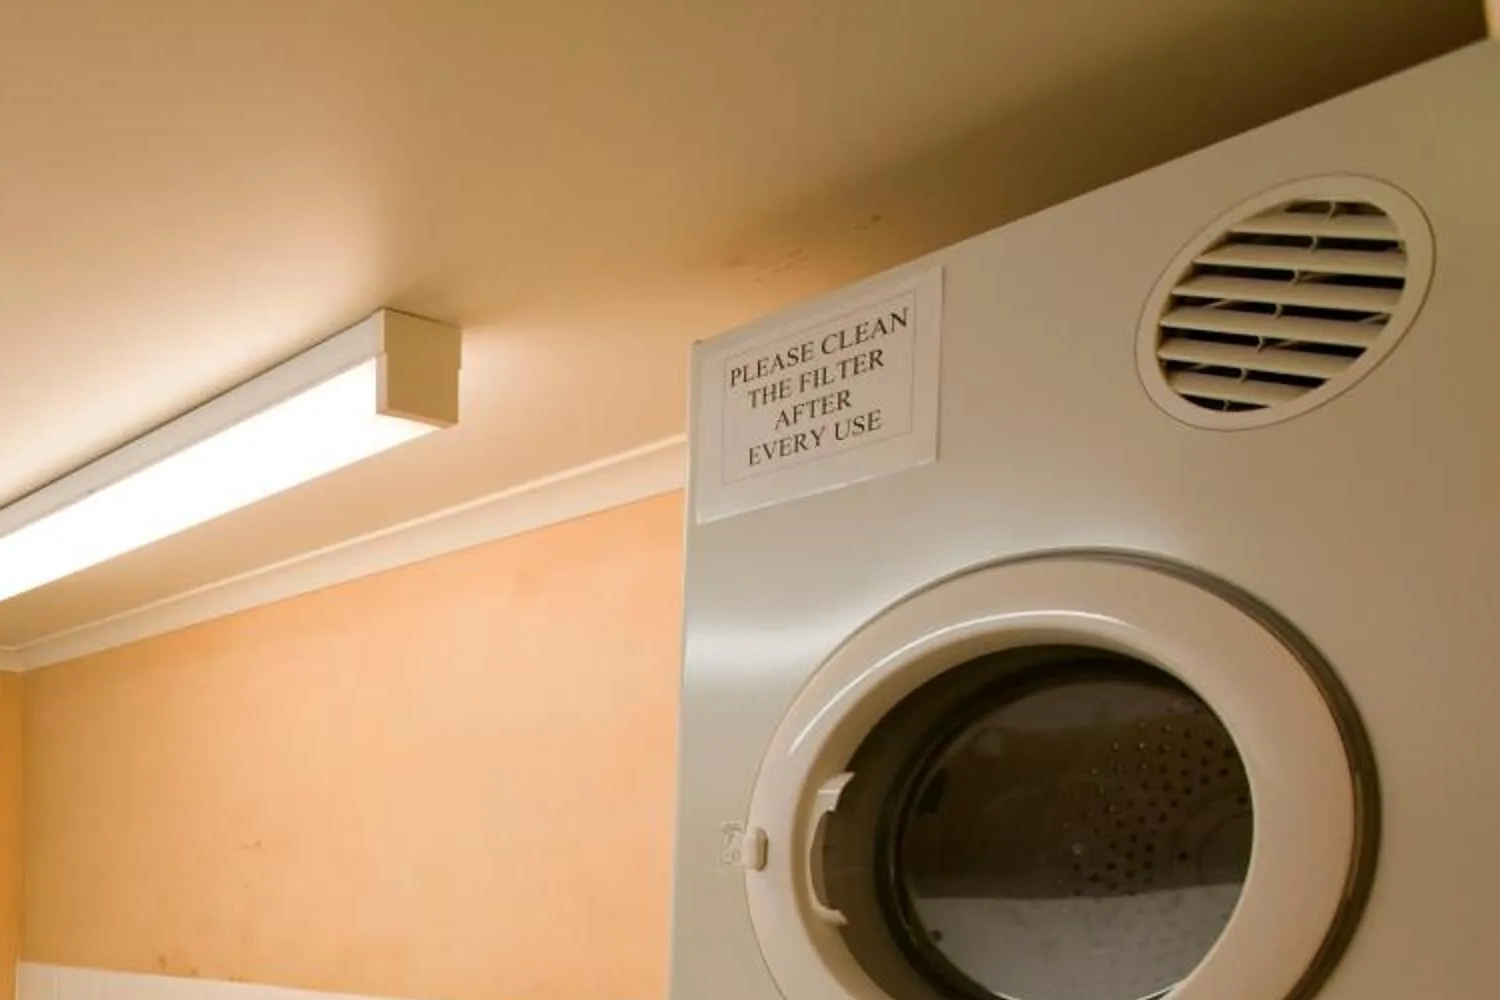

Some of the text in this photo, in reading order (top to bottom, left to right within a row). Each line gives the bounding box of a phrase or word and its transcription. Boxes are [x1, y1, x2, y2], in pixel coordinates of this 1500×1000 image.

[730, 307, 910, 388] PLEASE CLEAN
[747, 349, 885, 409] THE FILTER
[748, 409, 882, 467] EVERY USE
[775, 389, 852, 431] AFTER
